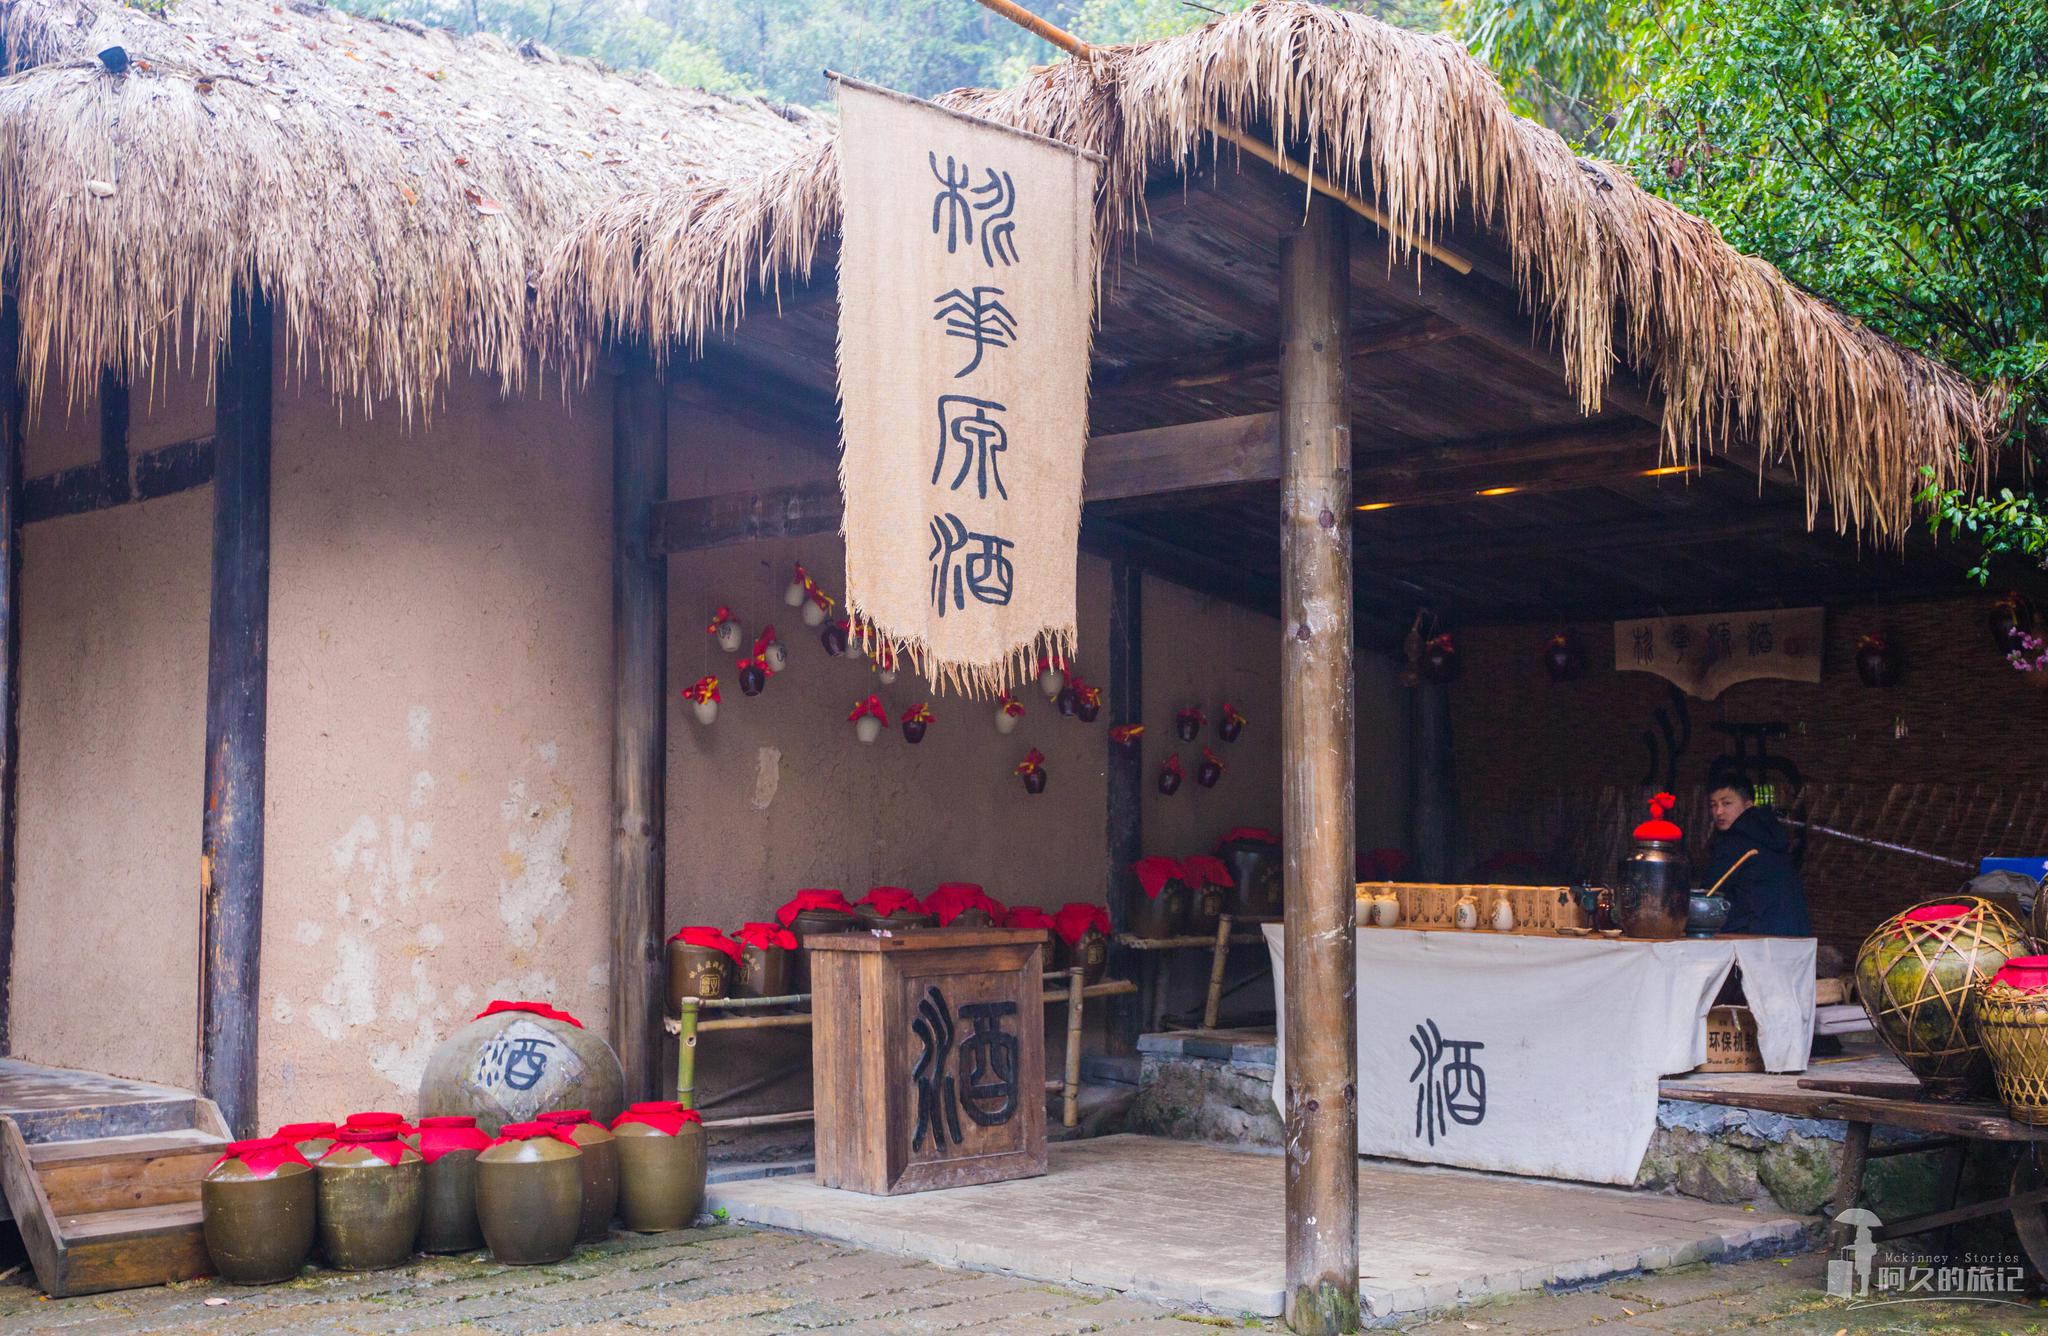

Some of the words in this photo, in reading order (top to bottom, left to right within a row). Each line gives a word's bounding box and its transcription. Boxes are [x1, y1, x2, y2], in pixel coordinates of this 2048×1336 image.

[478, 1036, 556, 1091] 酒
[912, 985, 1020, 1153] 酒
[1409, 1018, 1487, 1147] 酒
